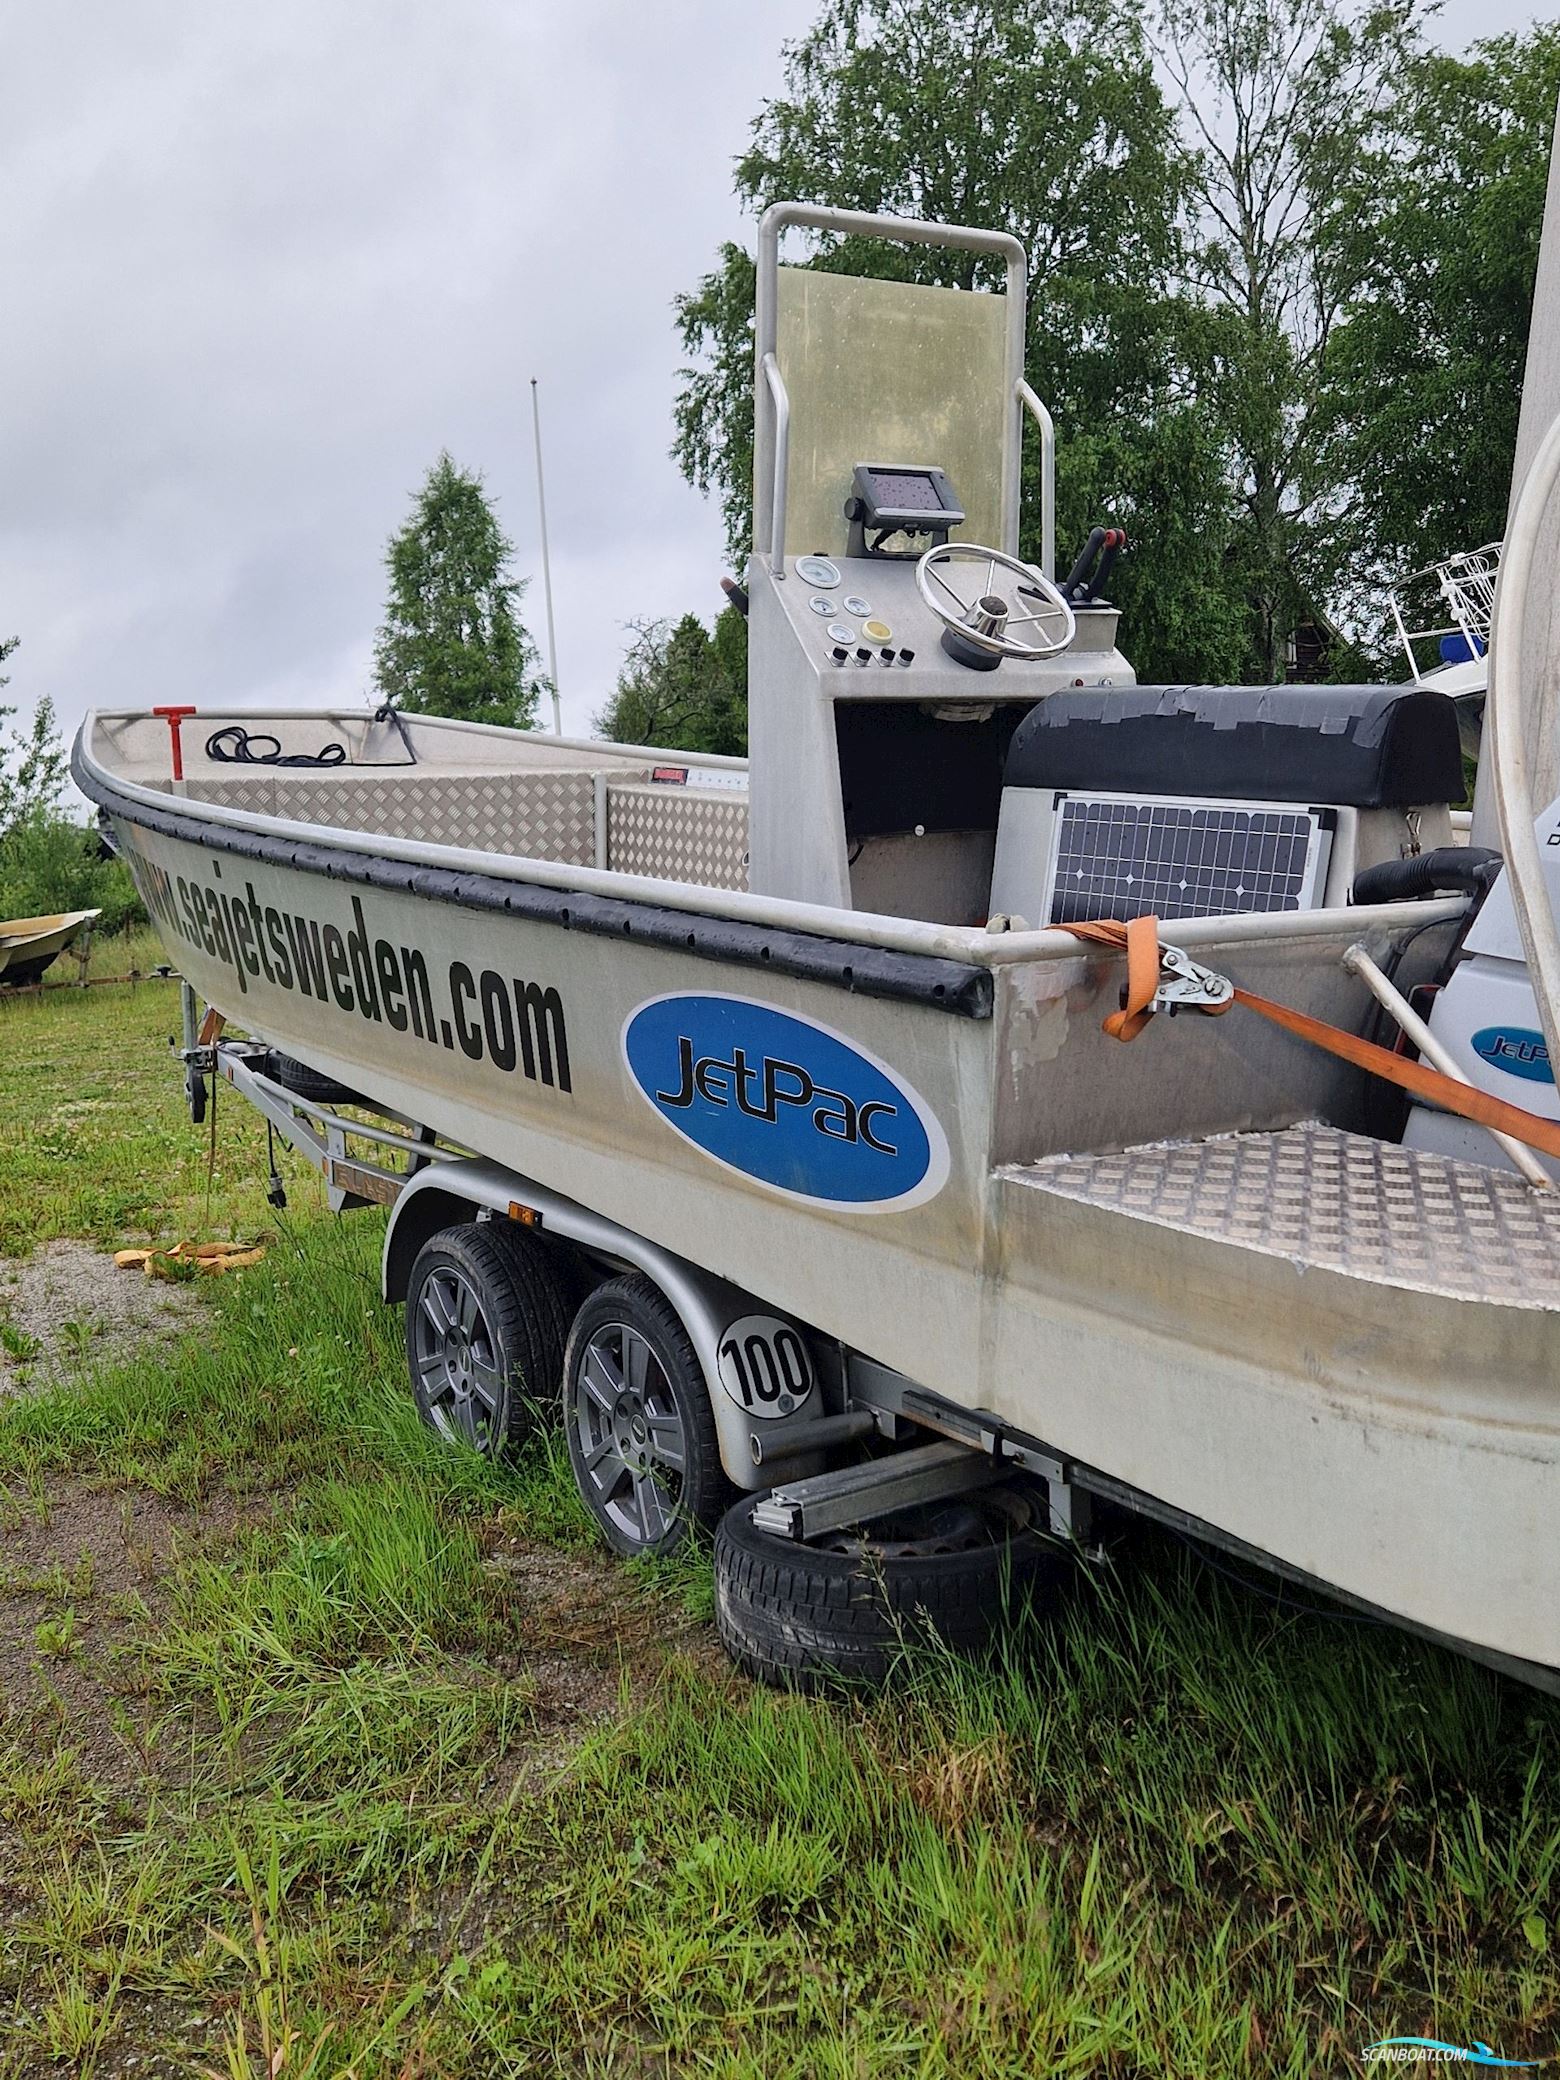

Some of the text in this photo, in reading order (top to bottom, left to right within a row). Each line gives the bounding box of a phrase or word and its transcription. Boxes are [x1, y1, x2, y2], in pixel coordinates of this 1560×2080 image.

[1480, 1035, 1551, 1066] JetP
[656, 1036, 898, 1156] JetPac
[721, 1329, 810, 1407] 100
